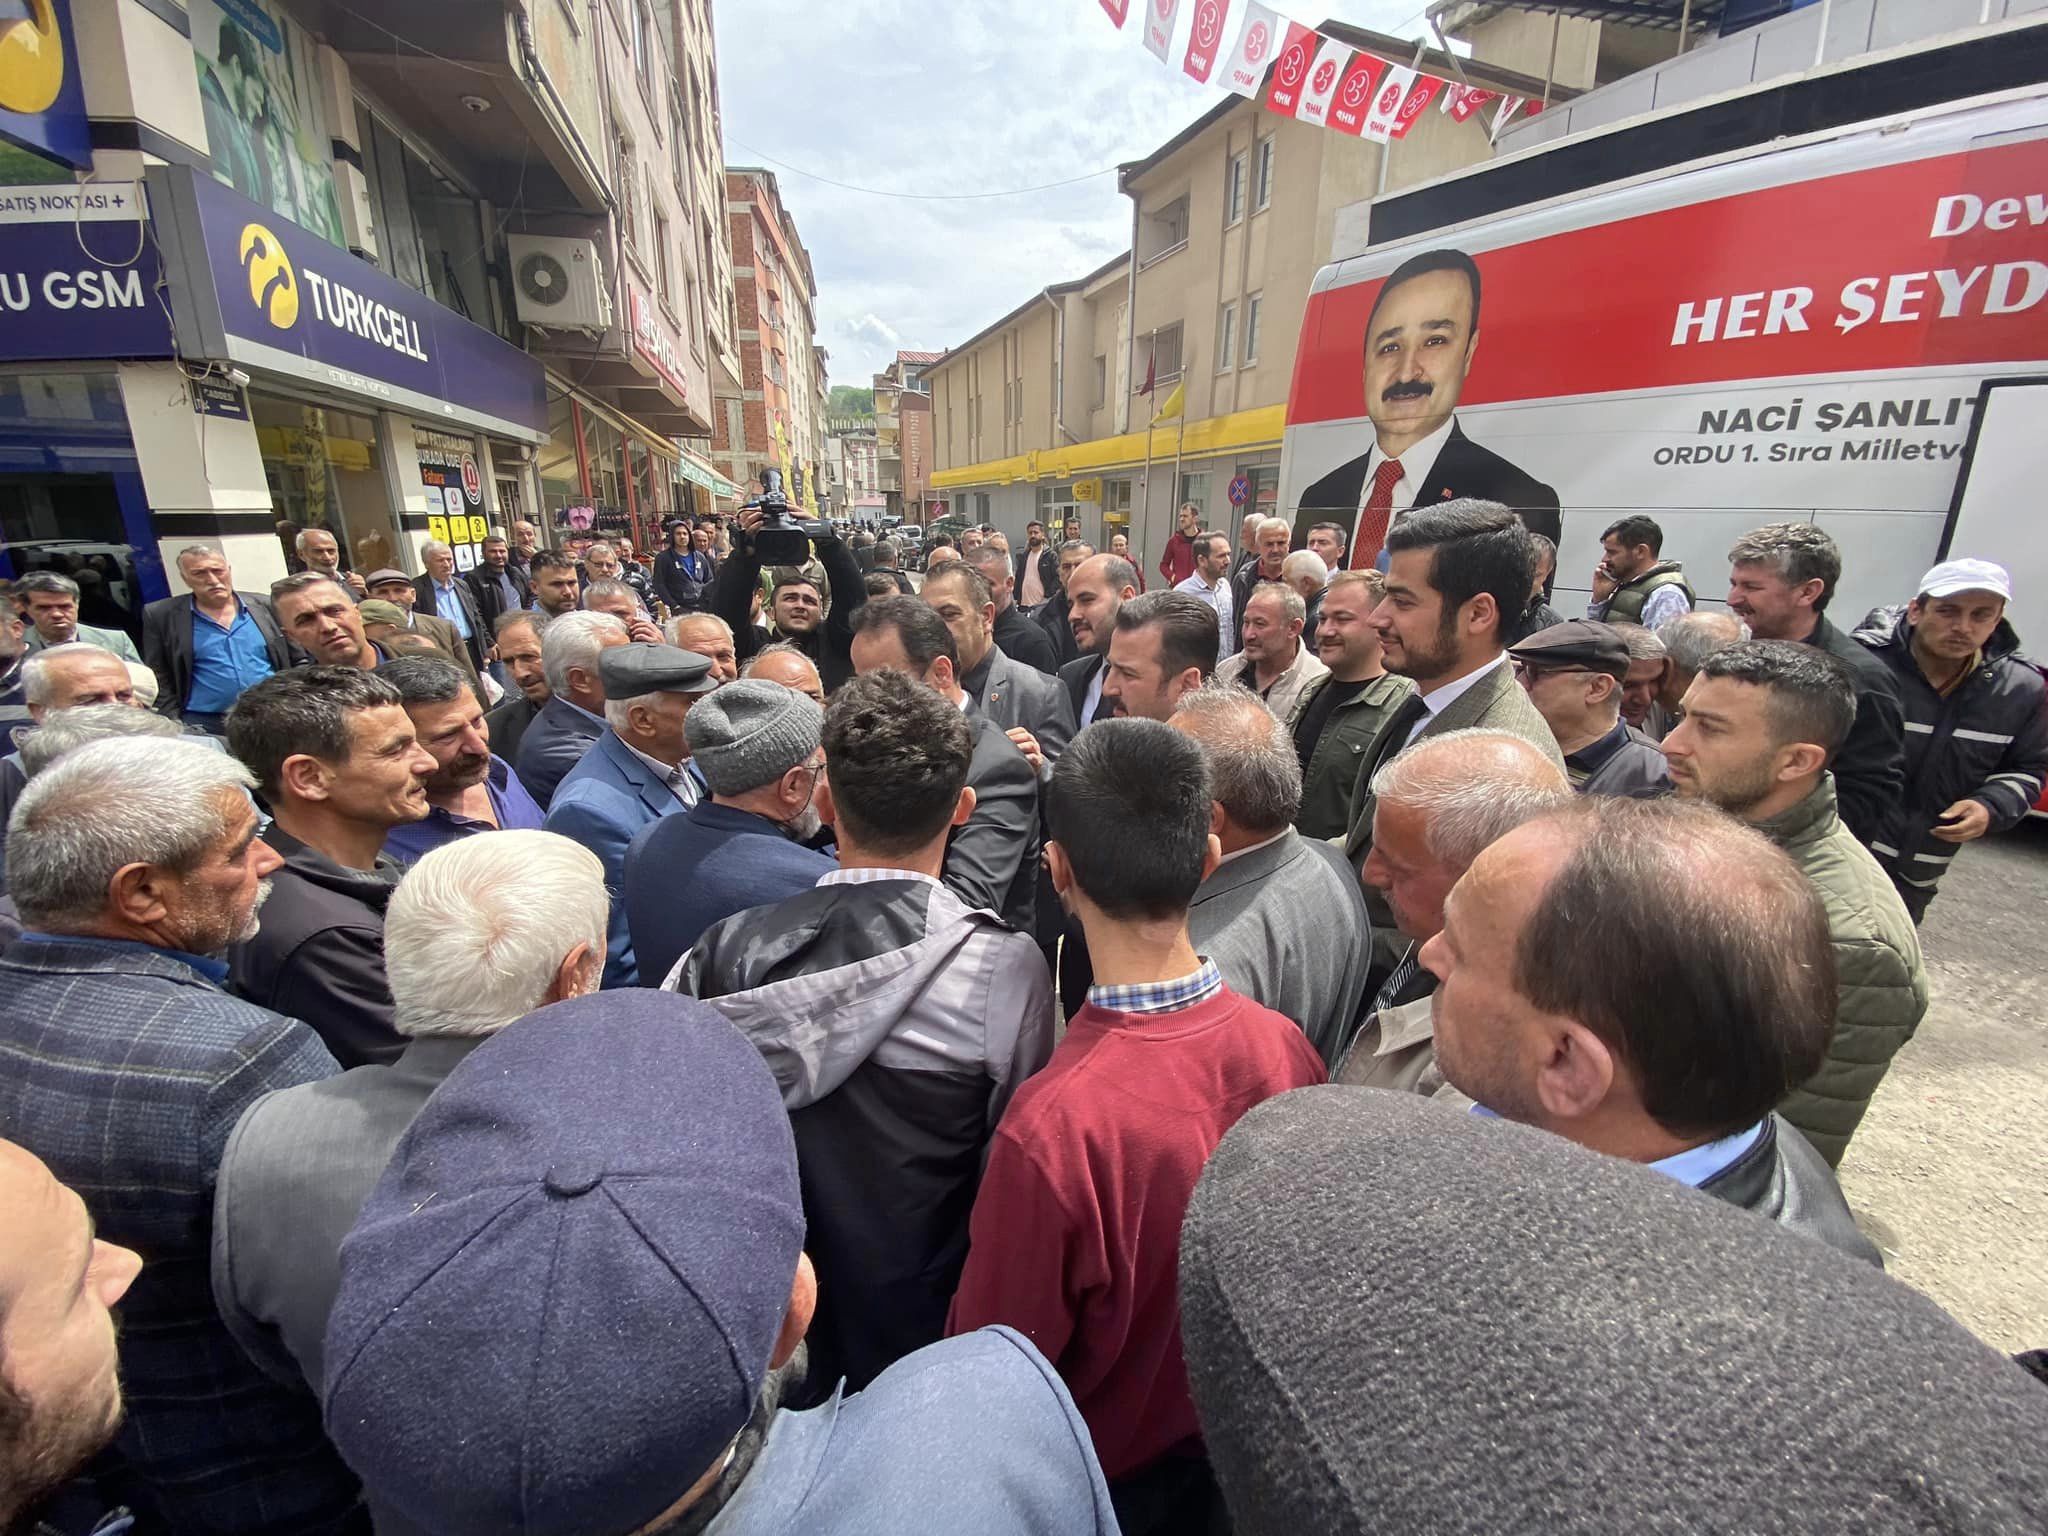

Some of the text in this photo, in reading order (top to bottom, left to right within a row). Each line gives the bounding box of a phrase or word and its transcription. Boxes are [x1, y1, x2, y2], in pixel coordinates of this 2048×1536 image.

[0, 270, 145, 311] U GSM
[1670, 260, 2048, 346] HER ŞEYD
[303, 268, 428, 362] TURKCELL
[1698, 398, 1803, 434] NACİ
[1653, 438, 1968, 465] ORDU 1. Sıra Milletv
